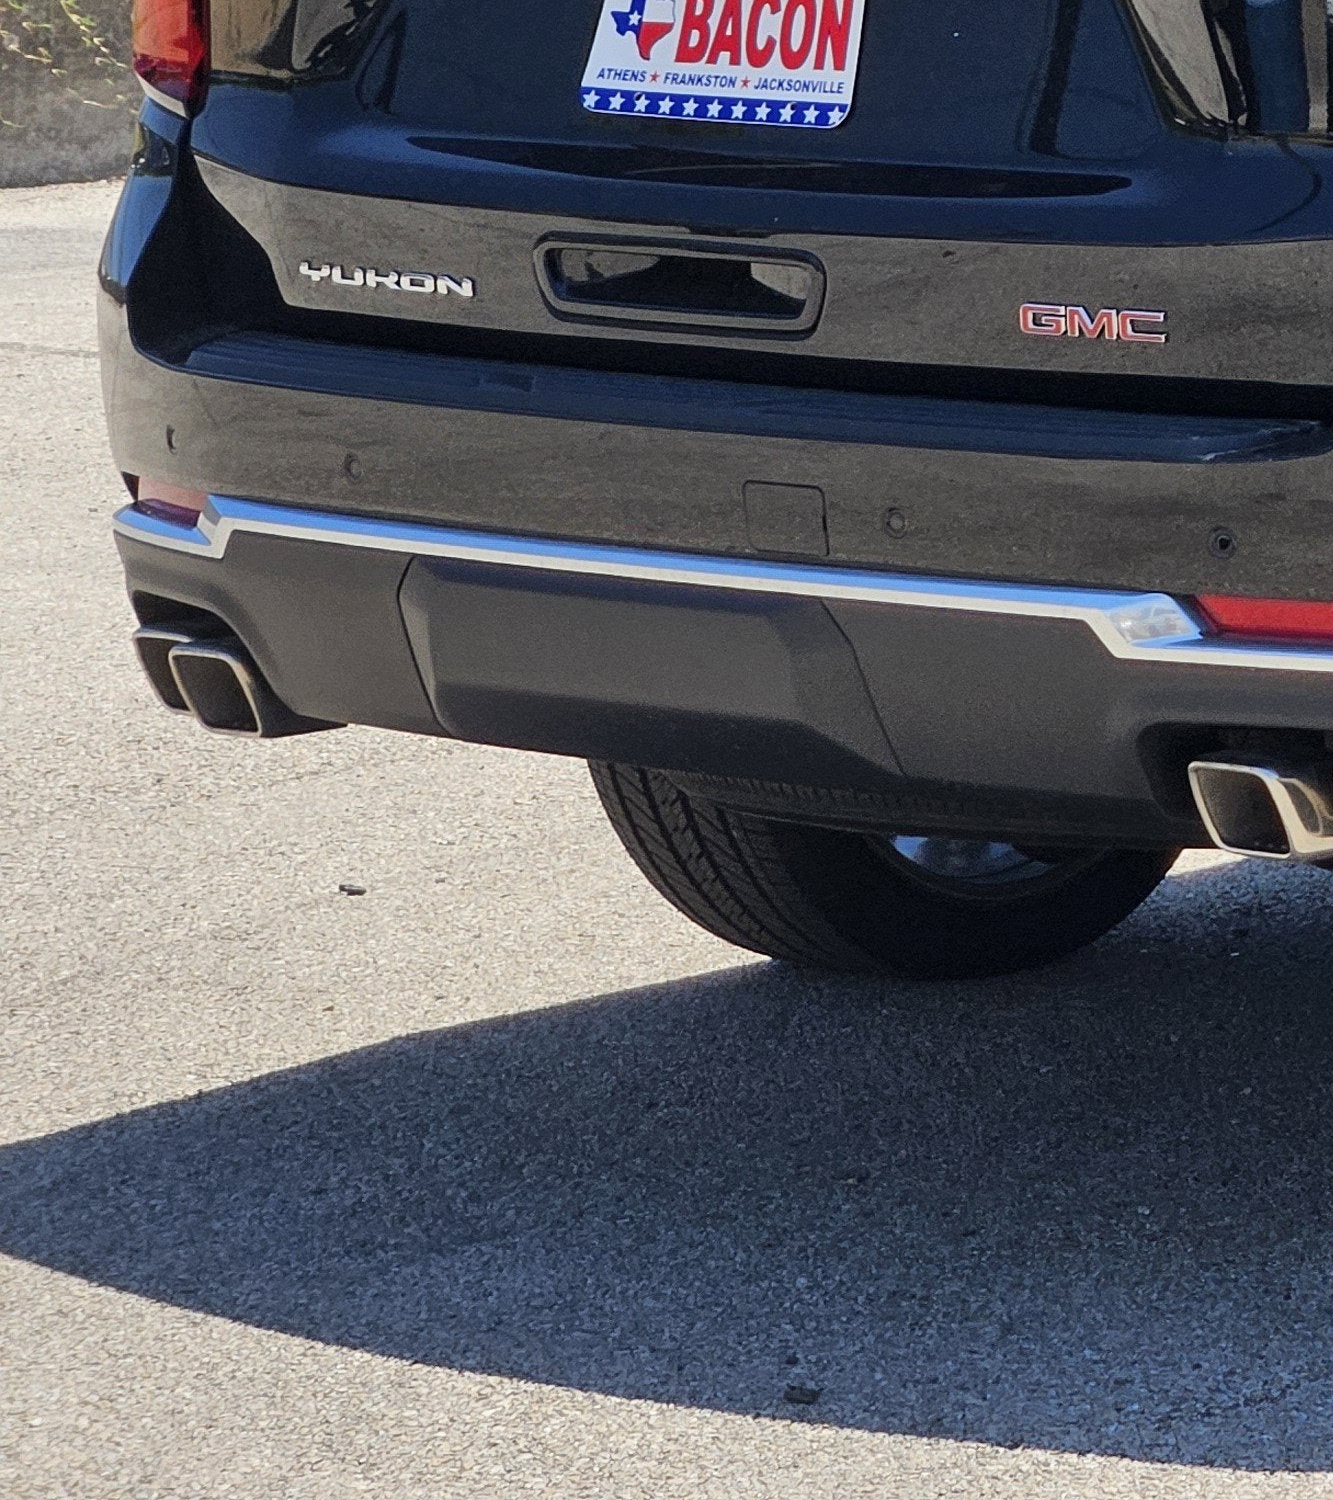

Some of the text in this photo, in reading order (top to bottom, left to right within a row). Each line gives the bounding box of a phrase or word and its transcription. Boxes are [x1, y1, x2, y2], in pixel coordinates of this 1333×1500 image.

[596, 67, 845, 94] ATHENS FRANKSTON JACKSONVILLE
[298, 261, 475, 298] YUKON
[1017, 303, 1168, 344] GMC
